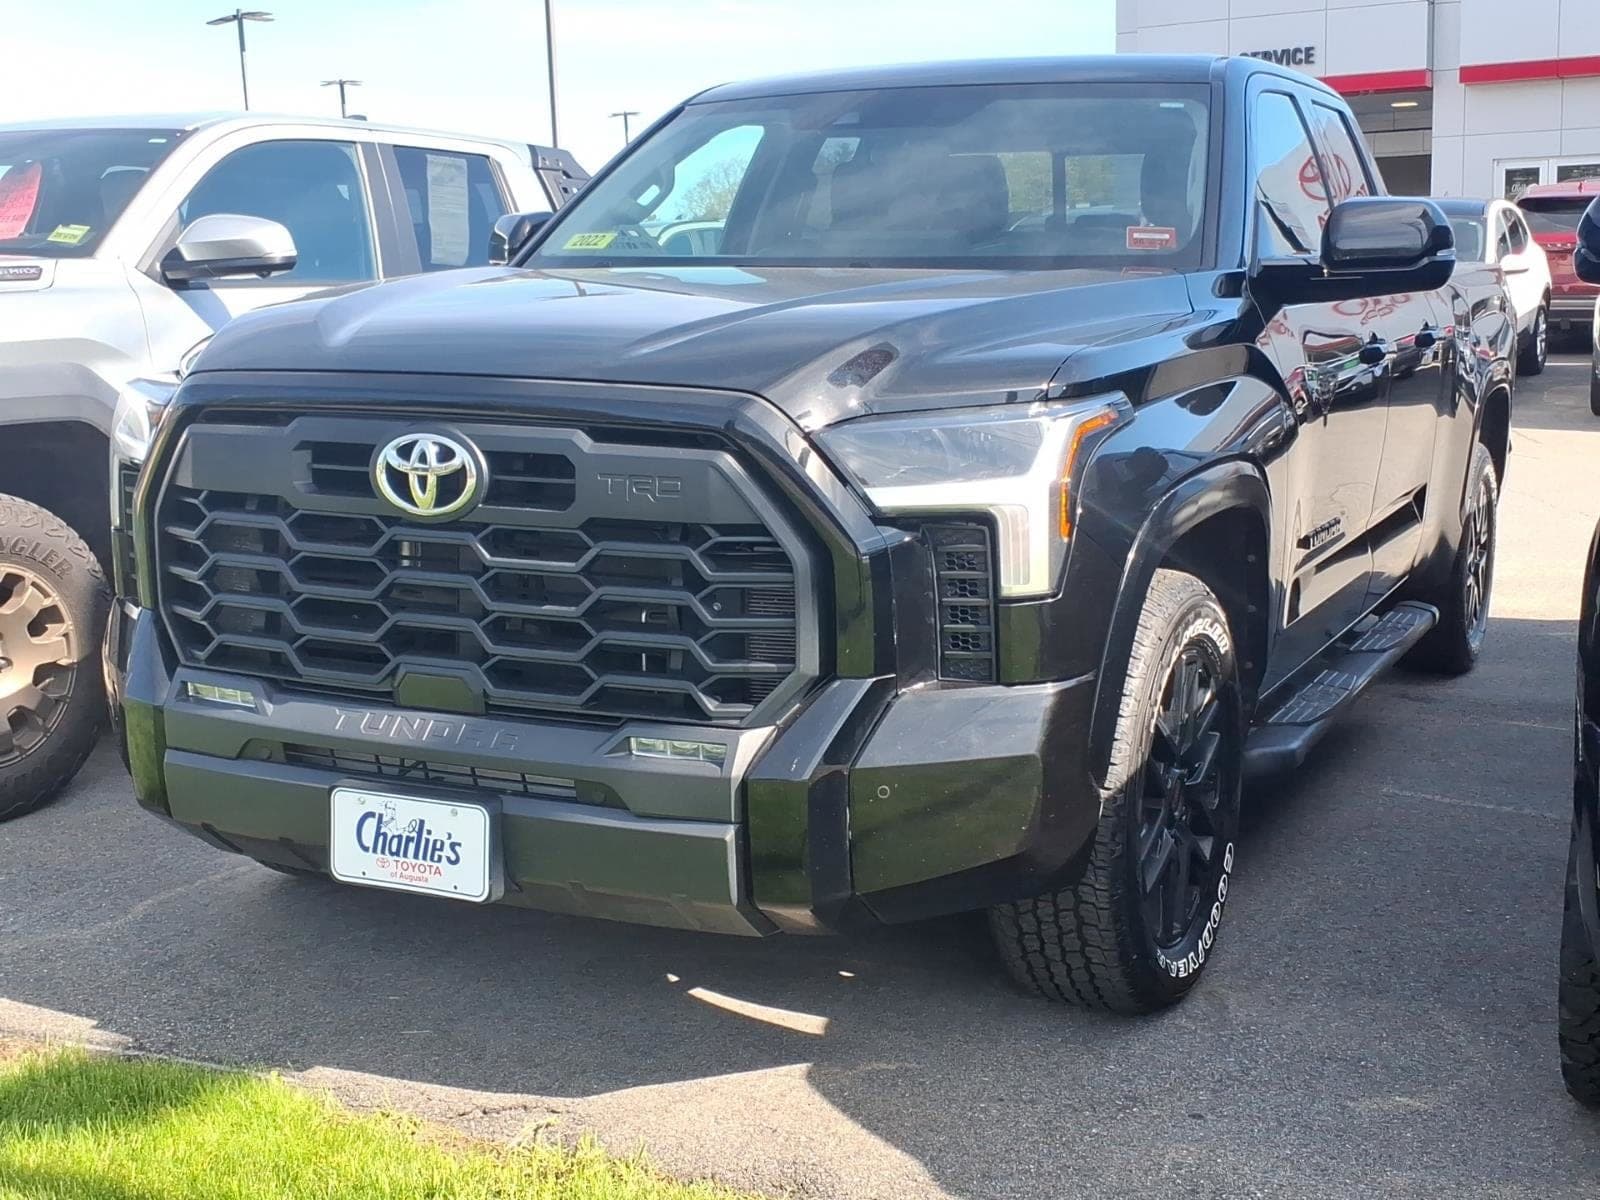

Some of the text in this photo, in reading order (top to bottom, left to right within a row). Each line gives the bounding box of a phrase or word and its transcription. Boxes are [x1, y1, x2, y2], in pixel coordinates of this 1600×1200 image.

[1240, 46, 1315, 66] RVICE
[571, 234, 607, 247] 2022
[597, 473, 682, 503] TRD
[334, 707, 521, 751] TUNDRA
[356, 811, 462, 866] Charlie's
[393, 859, 442, 877] TOYOTA
[399, 871, 429, 883] Augusta
[1157, 842, 1234, 978] GOODYEAR
